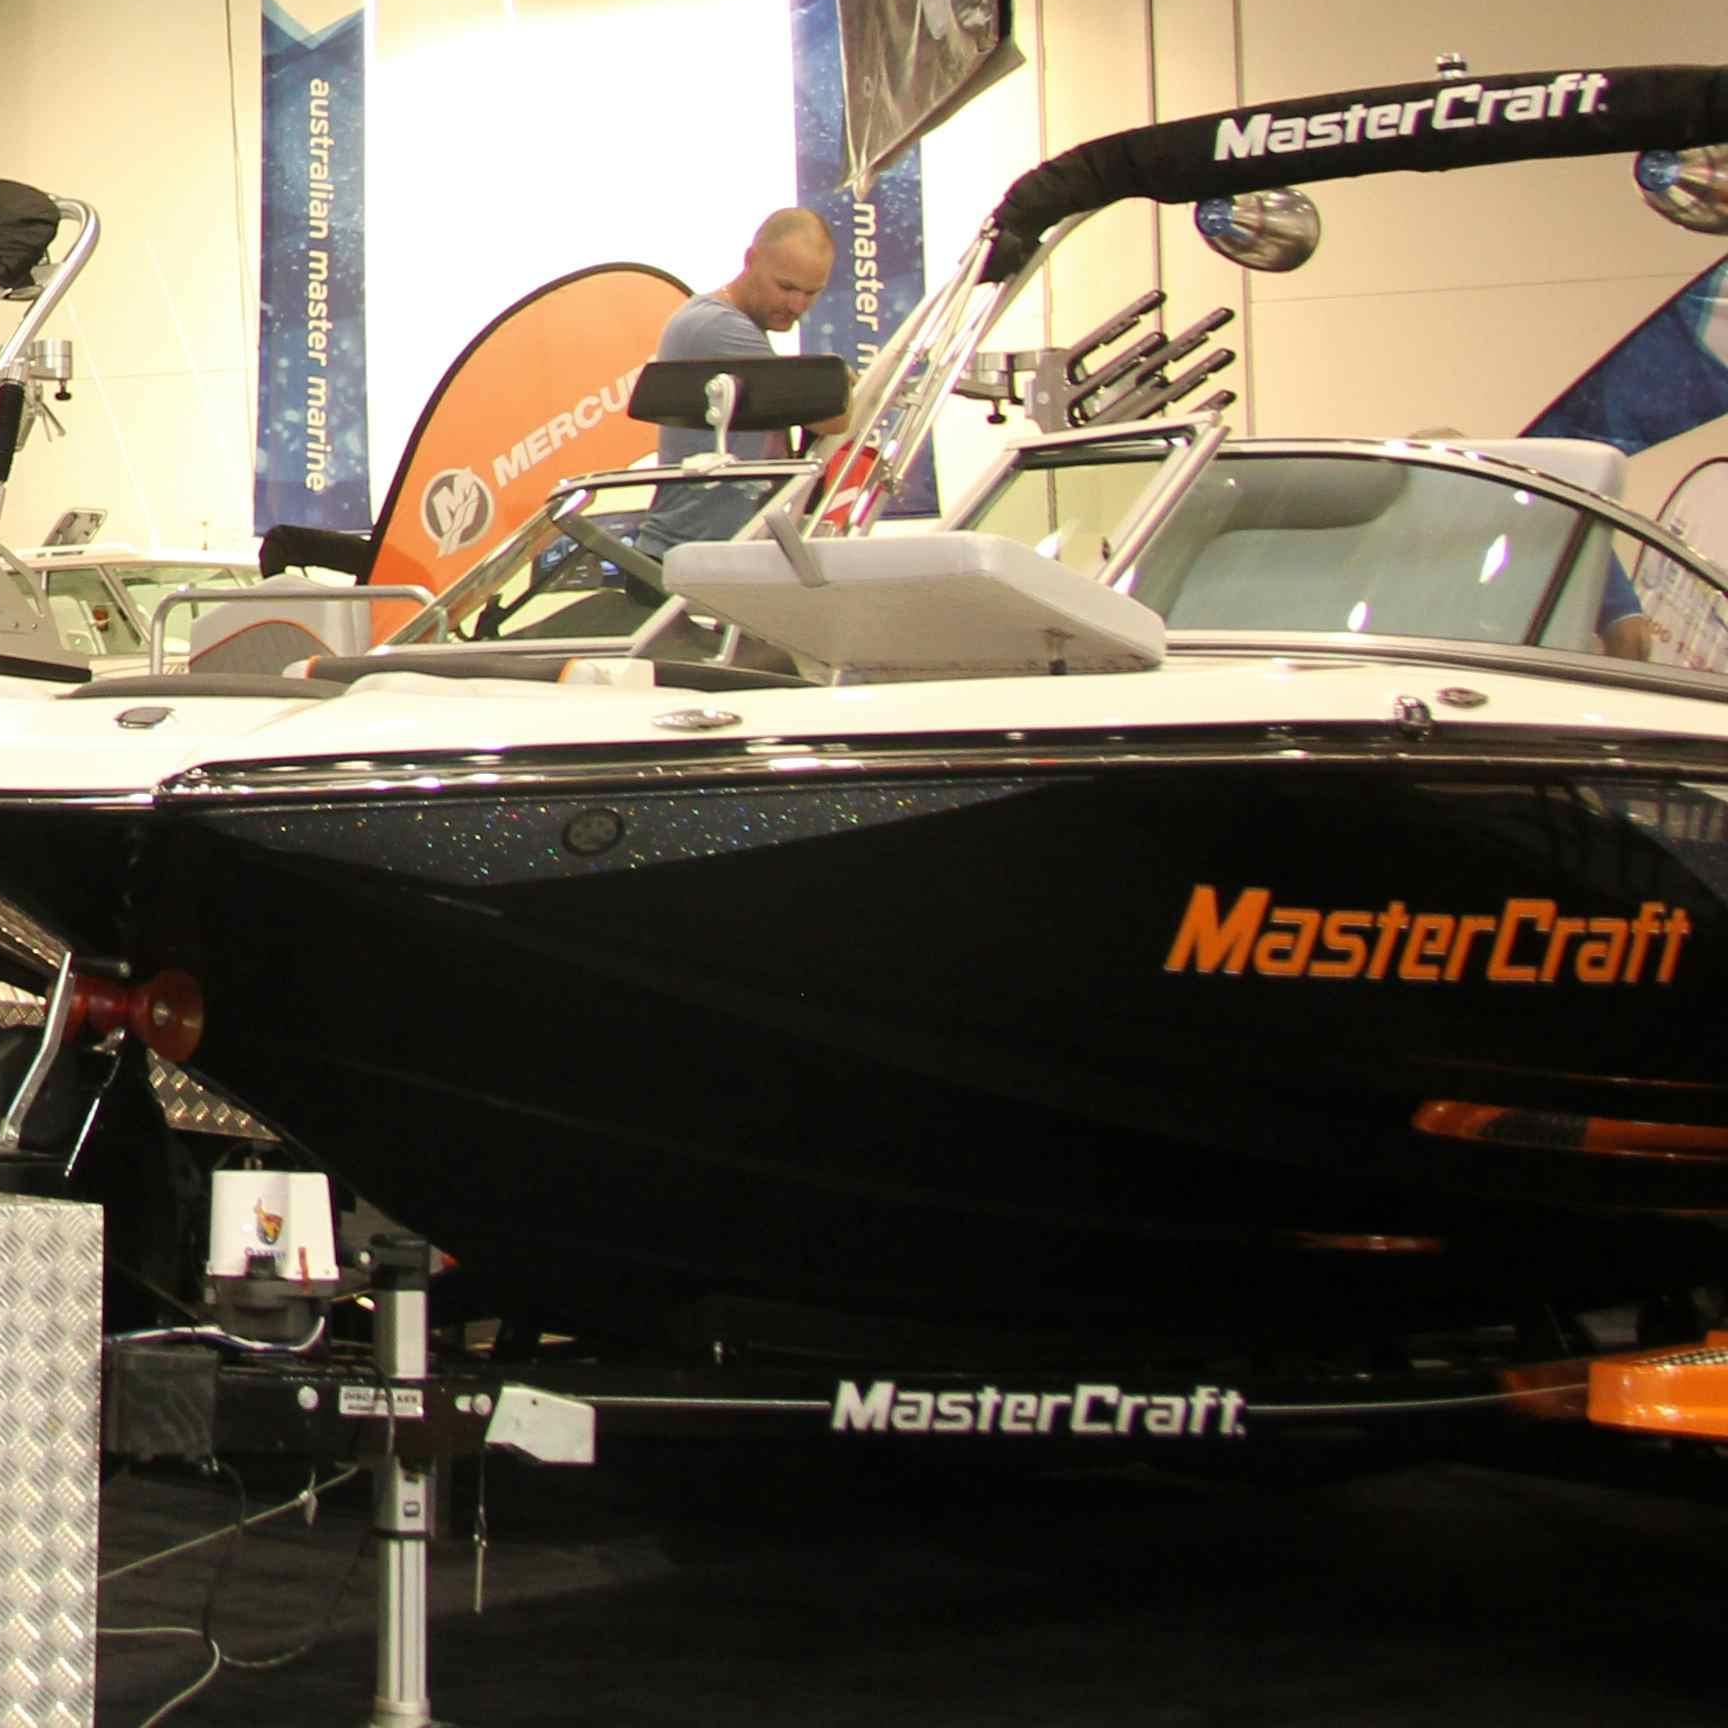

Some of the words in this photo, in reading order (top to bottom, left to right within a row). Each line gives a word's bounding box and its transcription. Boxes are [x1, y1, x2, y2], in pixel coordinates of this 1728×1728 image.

[308, 77, 335, 239] australian
[1214, 72, 1609, 161] MasterCraft
[307, 250, 334, 367] master
[853, 202, 886, 332] master
[305, 376, 333, 493] marine
[492, 354, 657, 488] MERCU
[1163, 883, 1694, 984] MasterCraft
[830, 1379, 1247, 1436] MasterCraft
